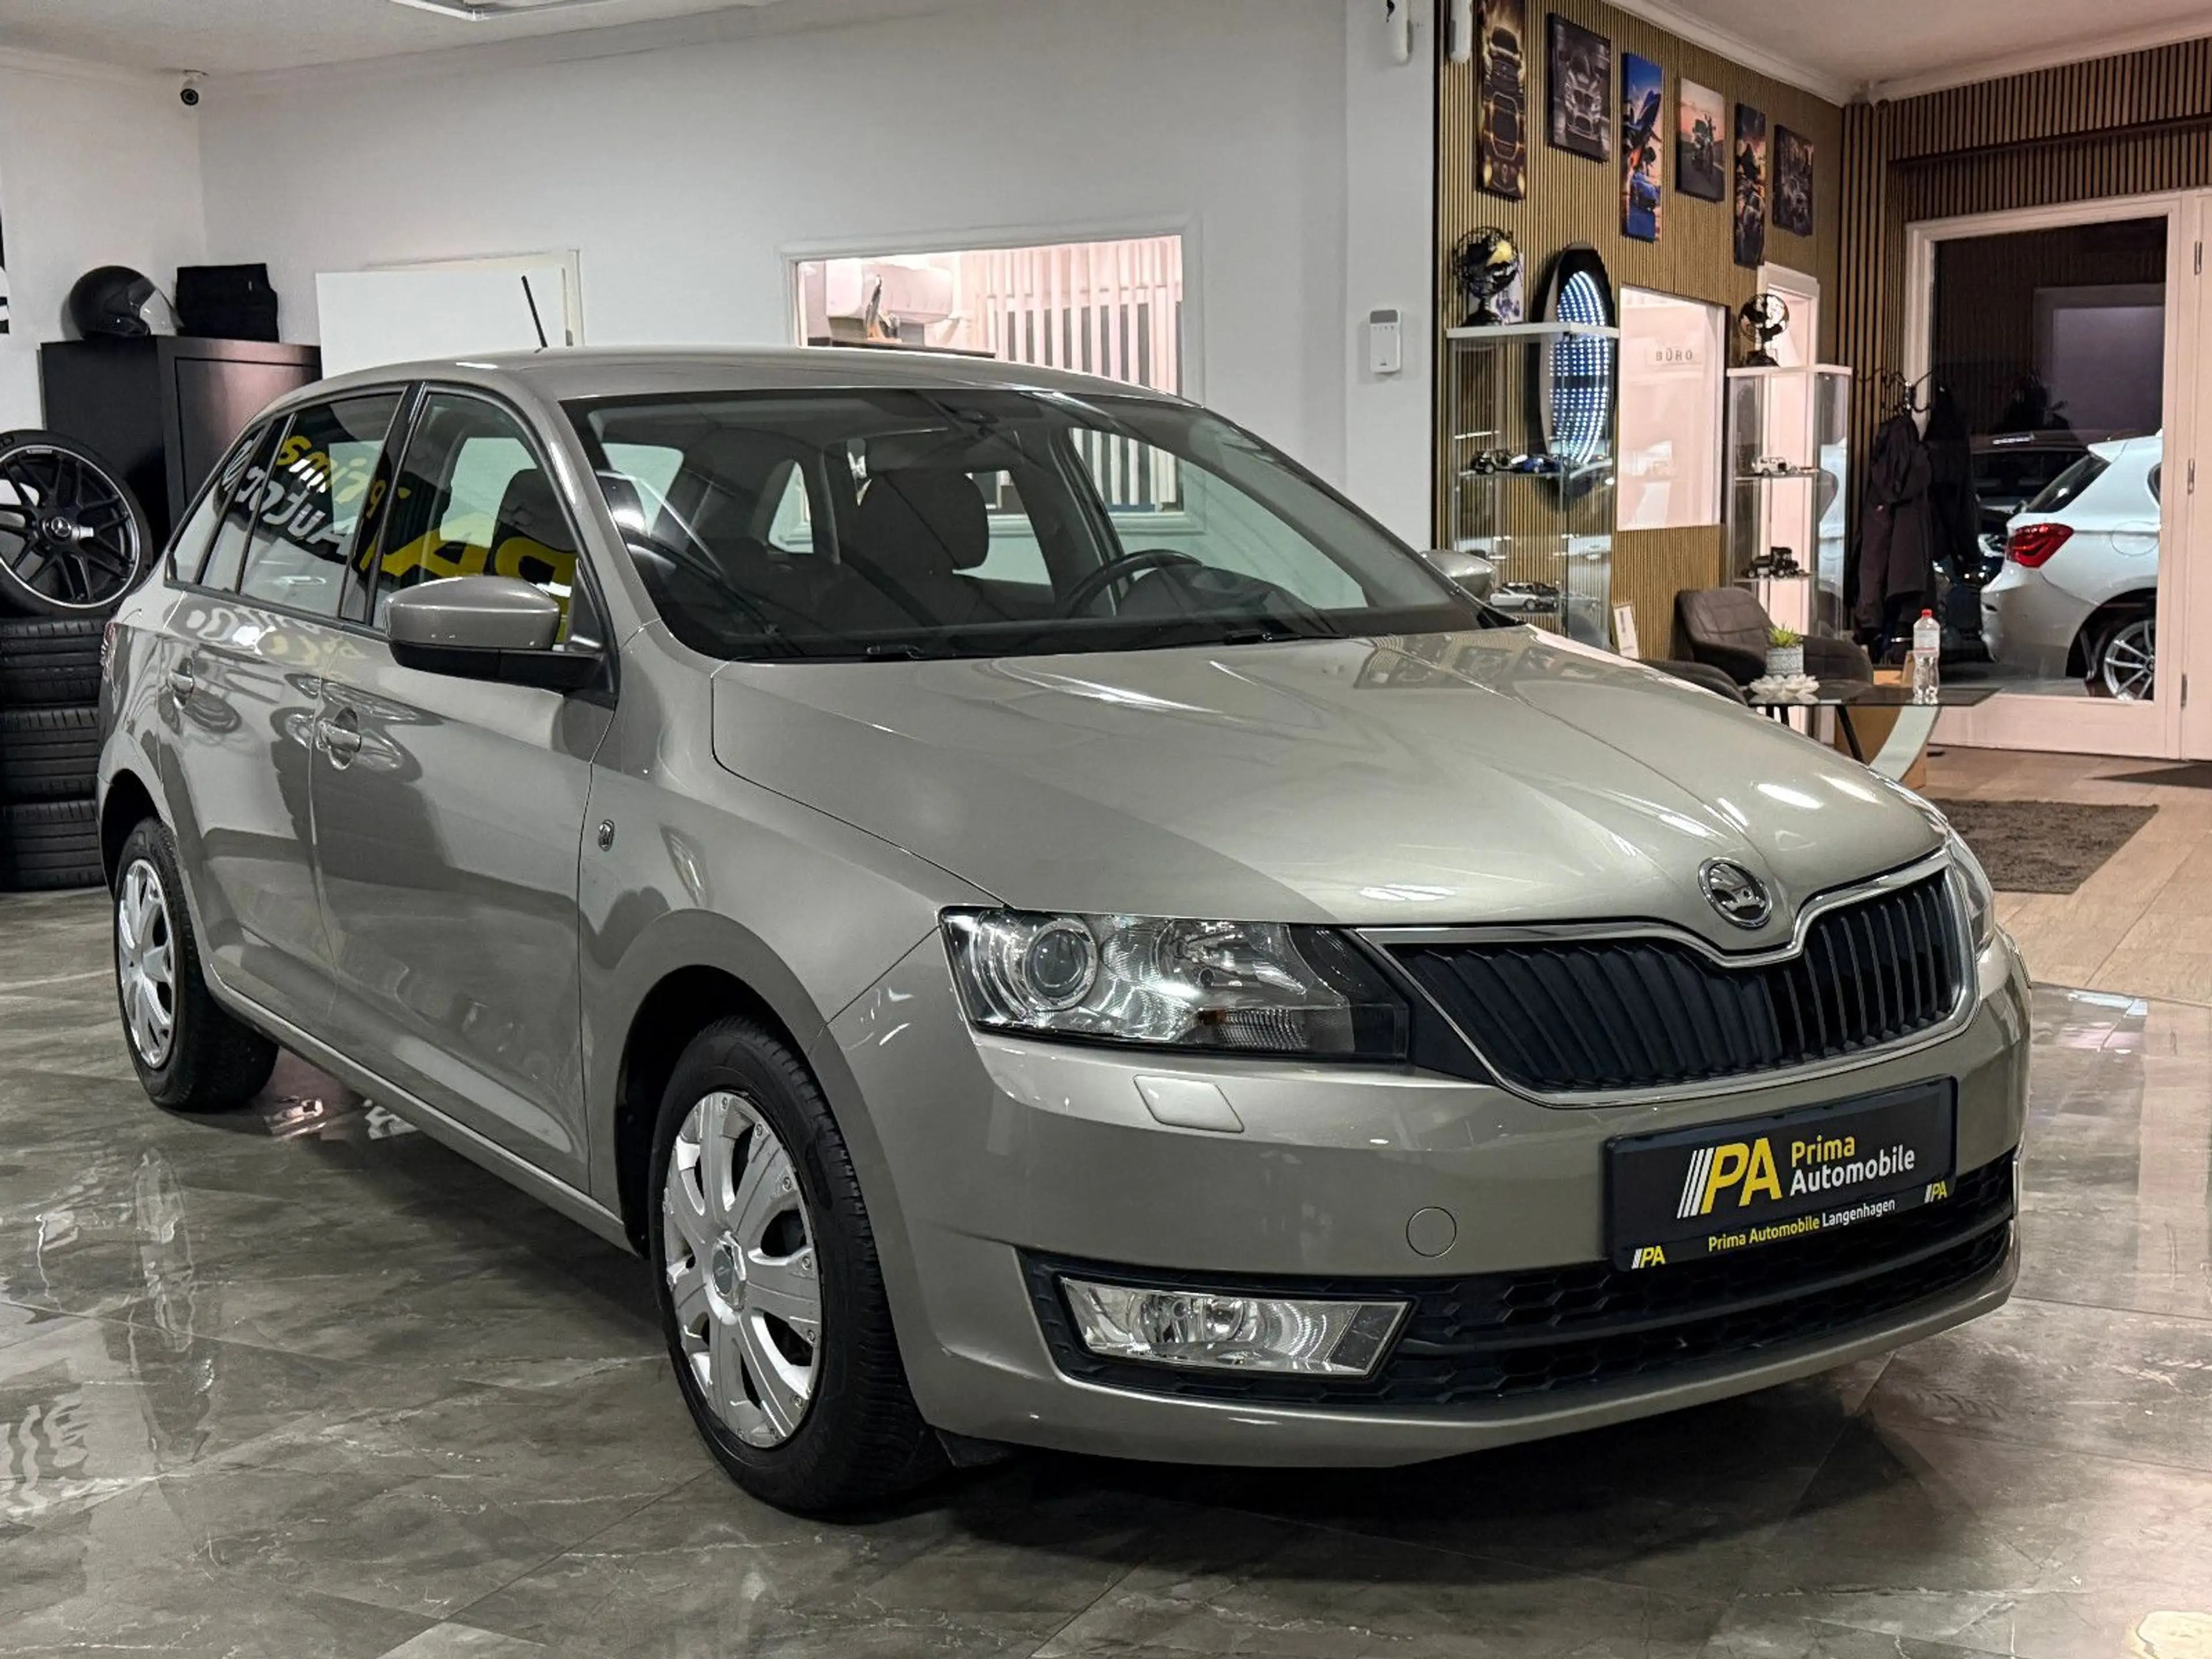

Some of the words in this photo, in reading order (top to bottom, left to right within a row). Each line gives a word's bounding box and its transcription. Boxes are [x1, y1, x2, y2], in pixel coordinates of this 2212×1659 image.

[1790, 1145, 1915, 1196] Automobile
[1791, 1135, 1855, 1167] Prima
[1708, 1232, 1746, 1252] Prima
[1749, 1217, 1820, 1244] Automobile
[1821, 1199, 1896, 1228] Langenhagen
